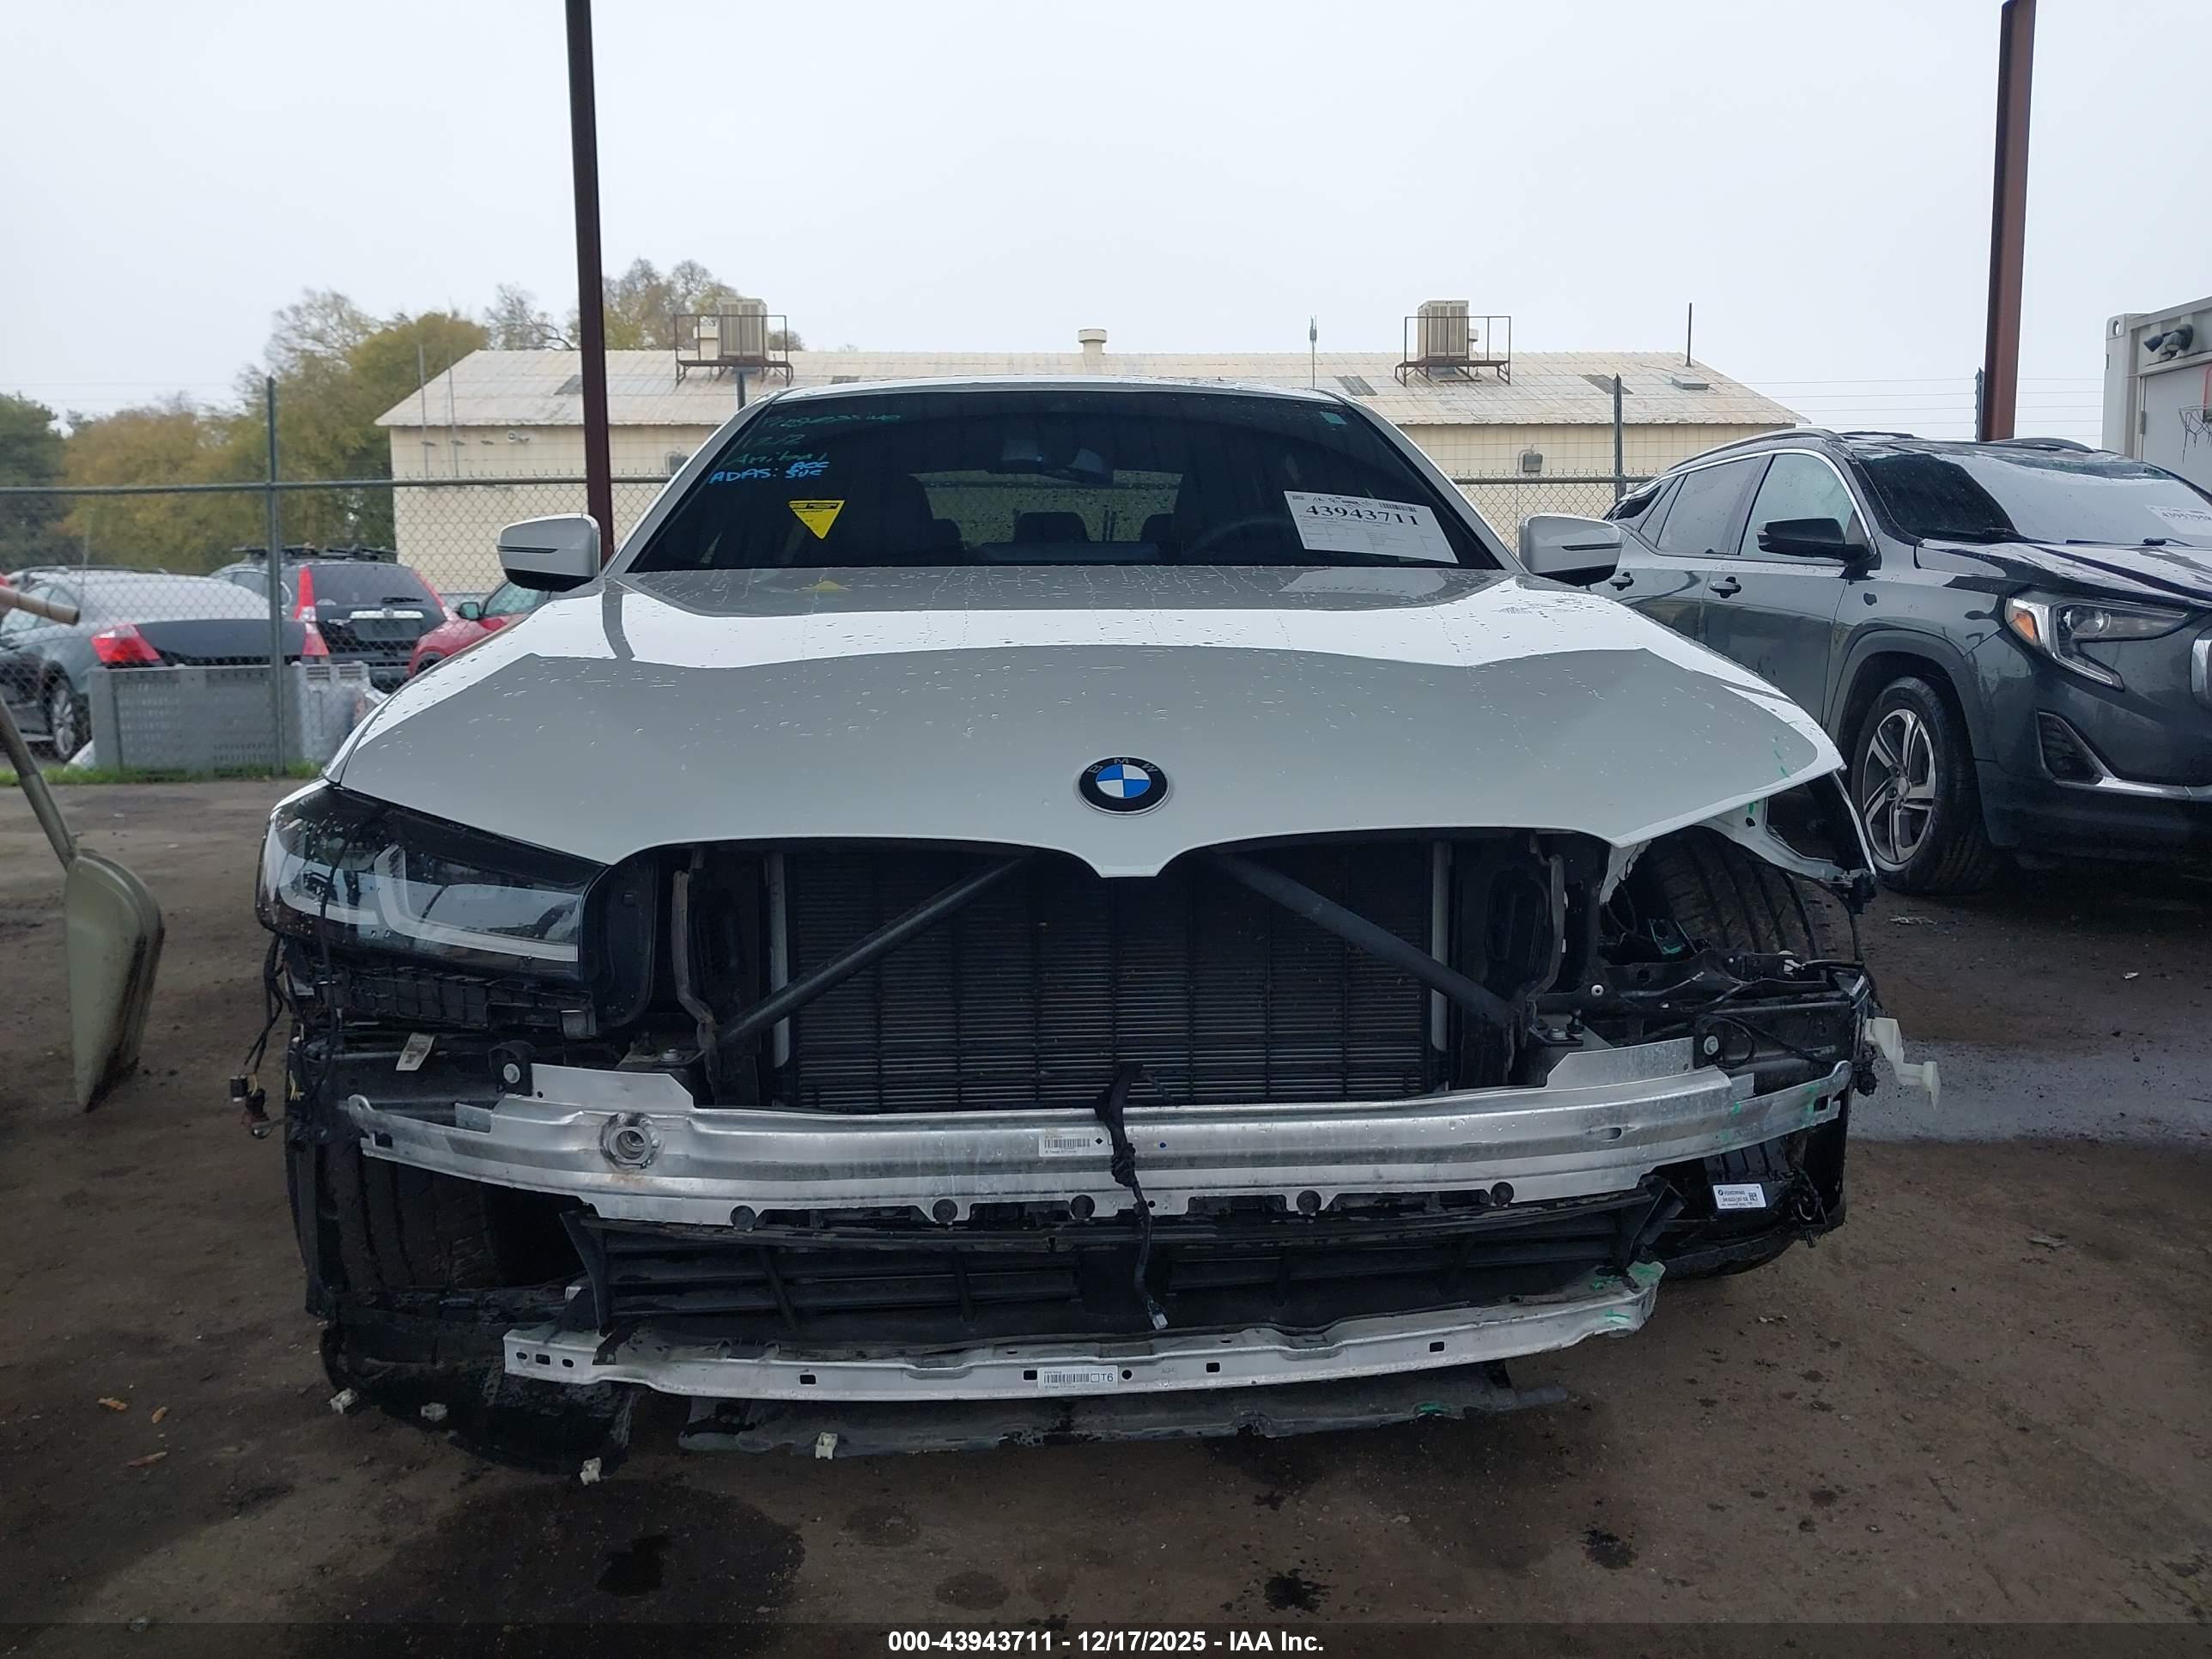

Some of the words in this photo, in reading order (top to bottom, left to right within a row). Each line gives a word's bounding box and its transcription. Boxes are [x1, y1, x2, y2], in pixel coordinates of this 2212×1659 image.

[1305, 504, 1419, 526] 43943711
[1087, 757, 1159, 774] BMW
[1103, 1372, 1114, 1382] T6
